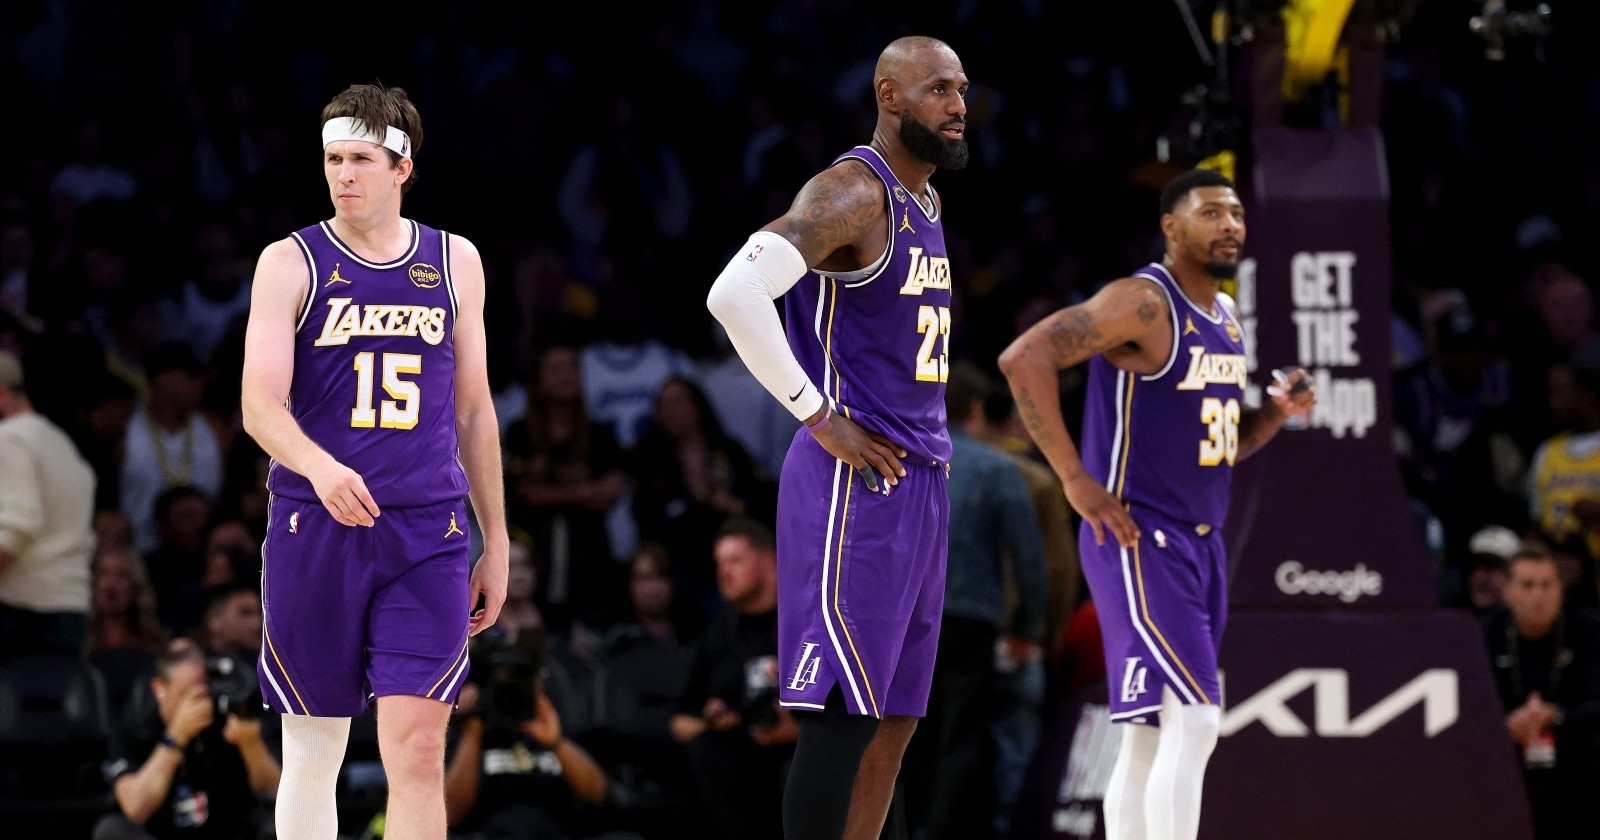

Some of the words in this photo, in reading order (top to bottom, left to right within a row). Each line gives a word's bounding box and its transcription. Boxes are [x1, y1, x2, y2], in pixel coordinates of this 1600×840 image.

[411, 269, 439, 282] bibigo
[899, 247, 952, 296] LAKE
[1291, 252, 1357, 308] GET
[314, 297, 446, 346] LAKERS
[915, 305, 951, 383] 23
[1292, 310, 1360, 367] THE
[351, 351, 422, 430] 15
[1198, 397, 1240, 467] 36
[1275, 561, 1383, 602] Google
[787, 642, 820, 691] LA
[1120, 656, 1148, 703] LA
